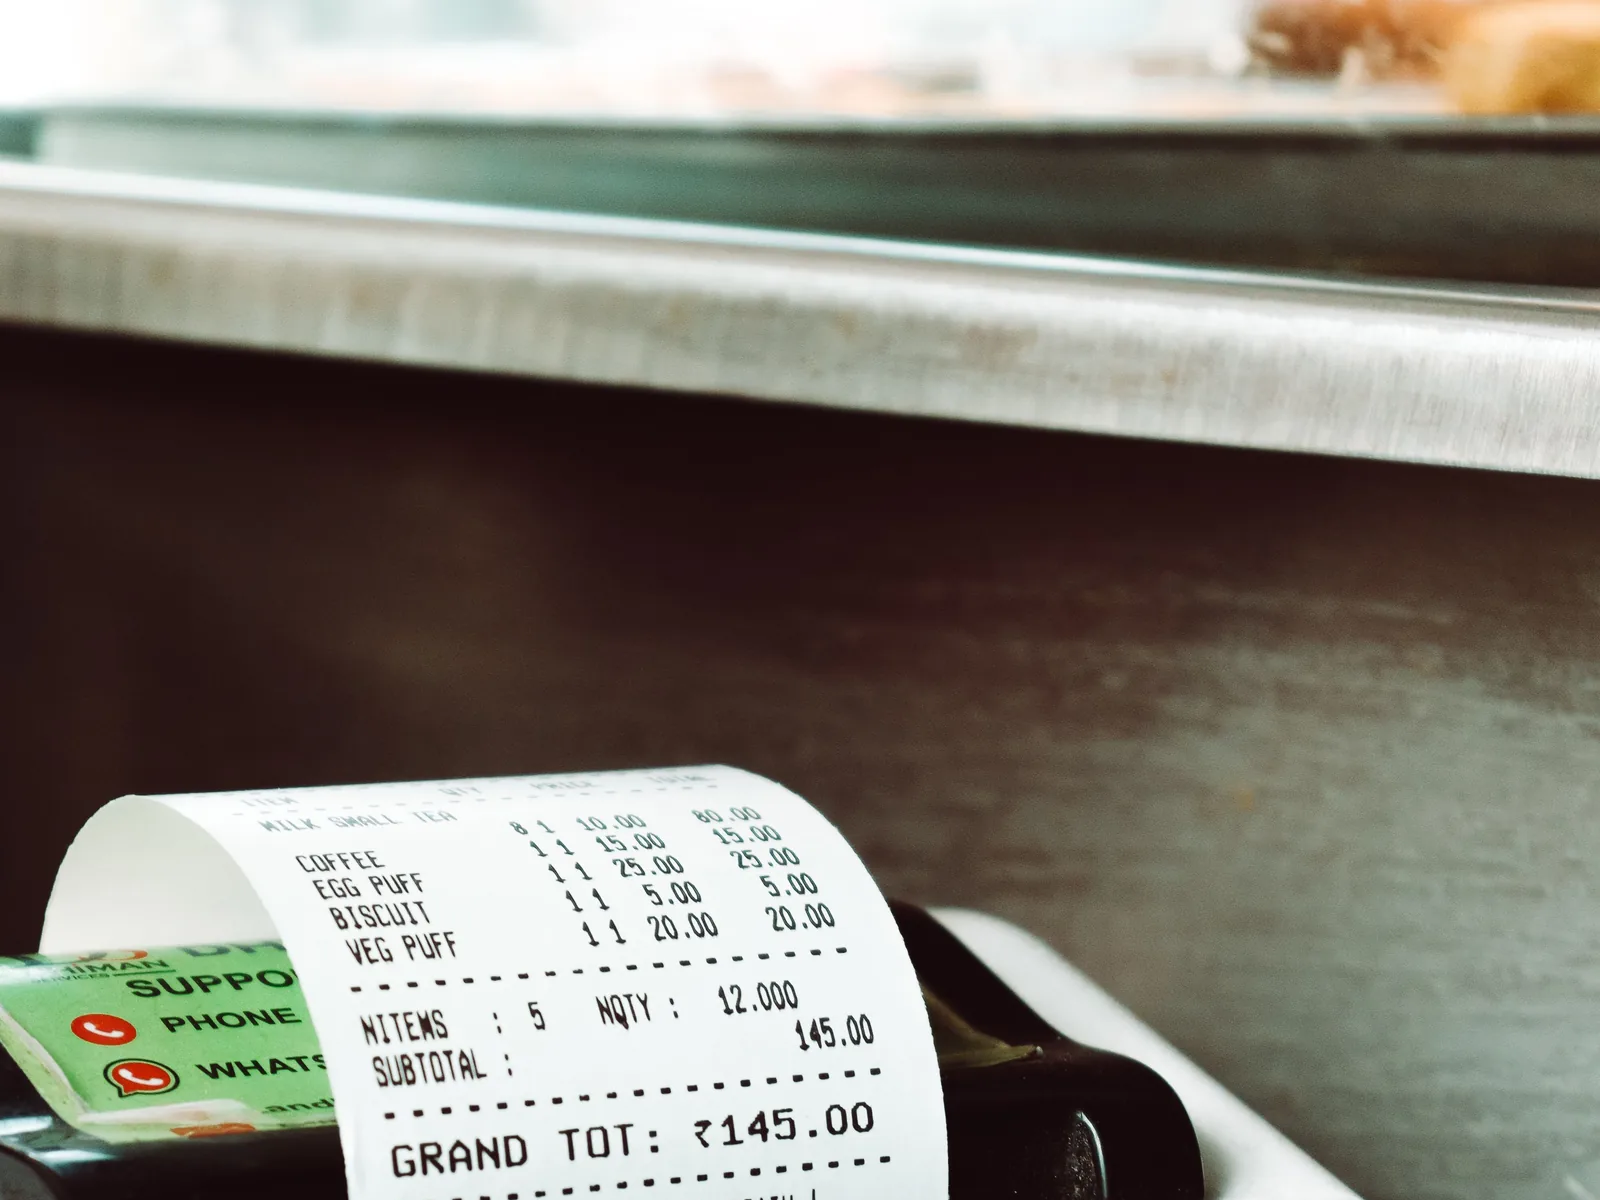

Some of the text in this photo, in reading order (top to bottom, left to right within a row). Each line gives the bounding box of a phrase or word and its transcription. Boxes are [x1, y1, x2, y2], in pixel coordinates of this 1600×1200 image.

[257, 806, 762, 835] MILK SMALL TEA 8 1 10.00 80.00
[295, 850, 386, 873] COFFEE
[595, 832, 666, 852] 15.00
[712, 824, 782, 845] 15.00
[312, 878, 362, 900] EGG
[368, 872, 425, 895] PUFF
[612, 855, 684, 878] 25.00
[729, 847, 800, 869] 25.00
[329, 901, 431, 930] BISCUIT
[641, 881, 702, 906] 5.00
[759, 873, 818, 897] 5.00
[345, 936, 394, 966] VEG
[400, 931, 457, 961] PUFF
[646, 912, 719, 942] 20.00
[764, 903, 836, 932] 20.00
[126, 967, 298, 998] SUPPO
[159, 1007, 302, 1033] PHONE
[360, 1009, 449, 1046] NITEMS
[527, 1001, 546, 1031] 5
[595, 993, 651, 1030] NQTY
[718, 980, 799, 1016] 12.000
[196, 1054, 328, 1079] WHATS
[372, 1048, 488, 1088] SUBTOTAL
[795, 1013, 875, 1051] 145.00
[391, 1101, 875, 1178] GRAND TOT: ₹145.00
